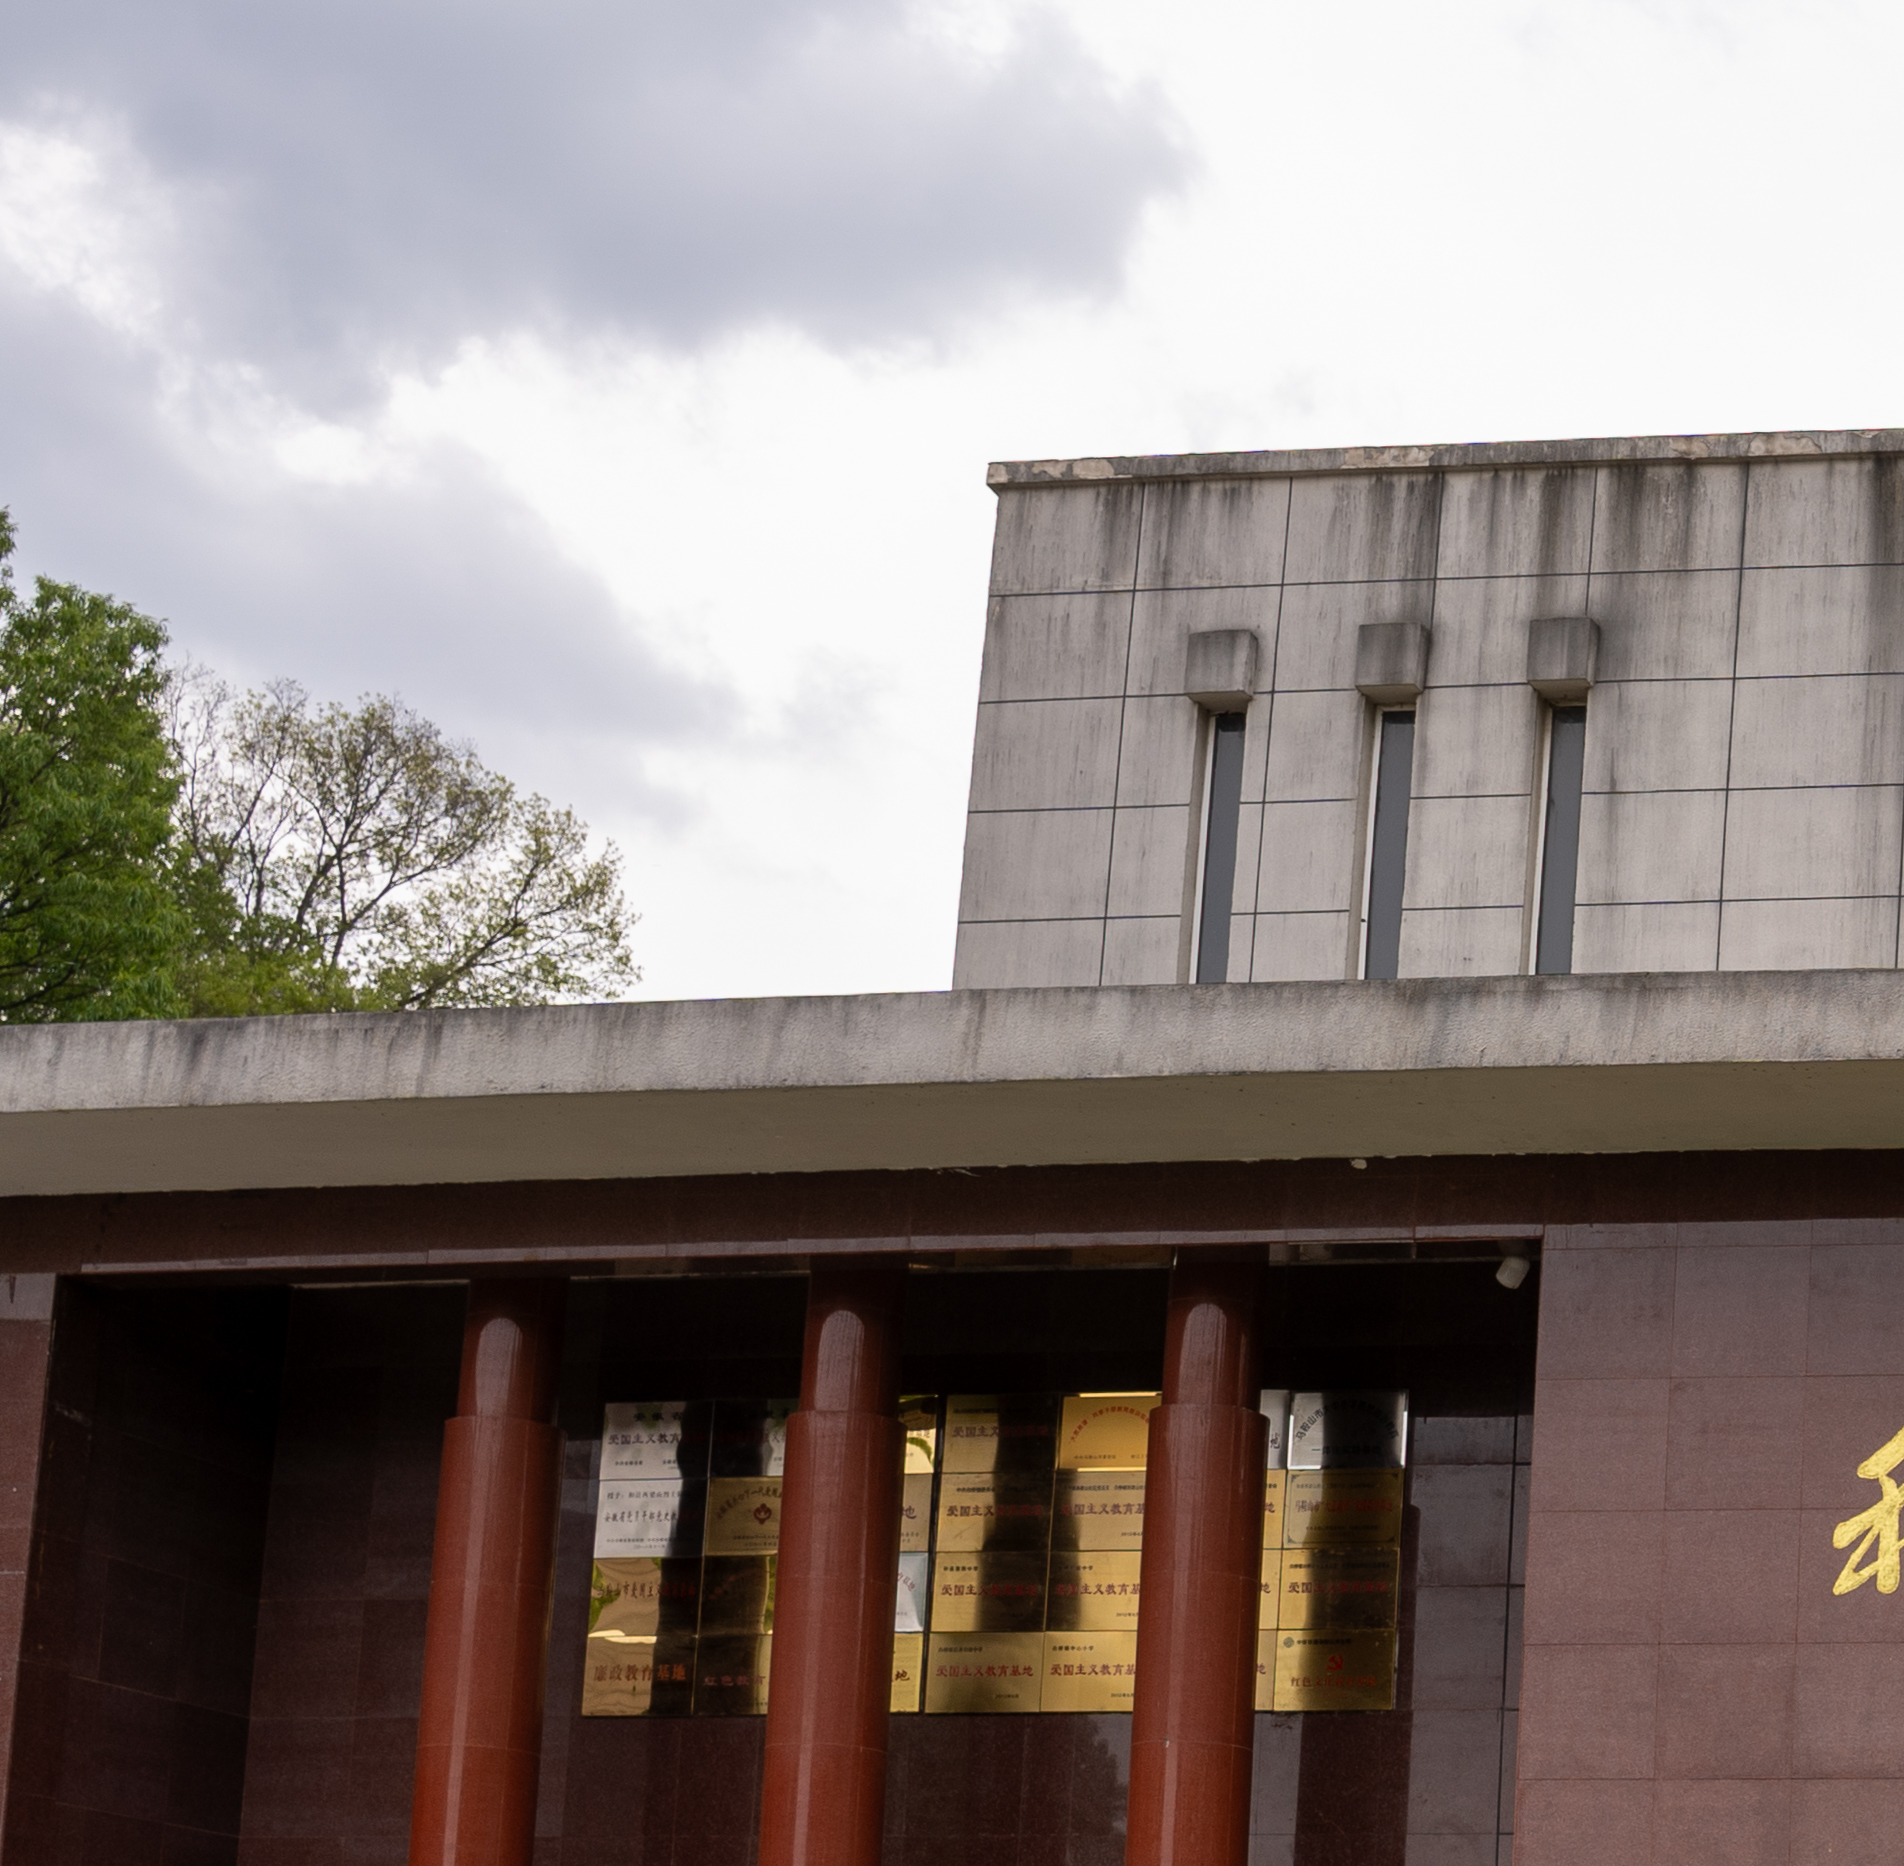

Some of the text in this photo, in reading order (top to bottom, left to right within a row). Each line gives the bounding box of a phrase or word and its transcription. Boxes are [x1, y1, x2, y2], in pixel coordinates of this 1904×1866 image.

[1059, 1504, 1145, 1517] 爱国主义教育基
[1054, 1583, 1141, 1596] 爱国主义教育基
[935, 1664, 1035, 1678] 爱国主义教育基地
[1050, 1663, 1136, 1677] 爱国主义教育基
